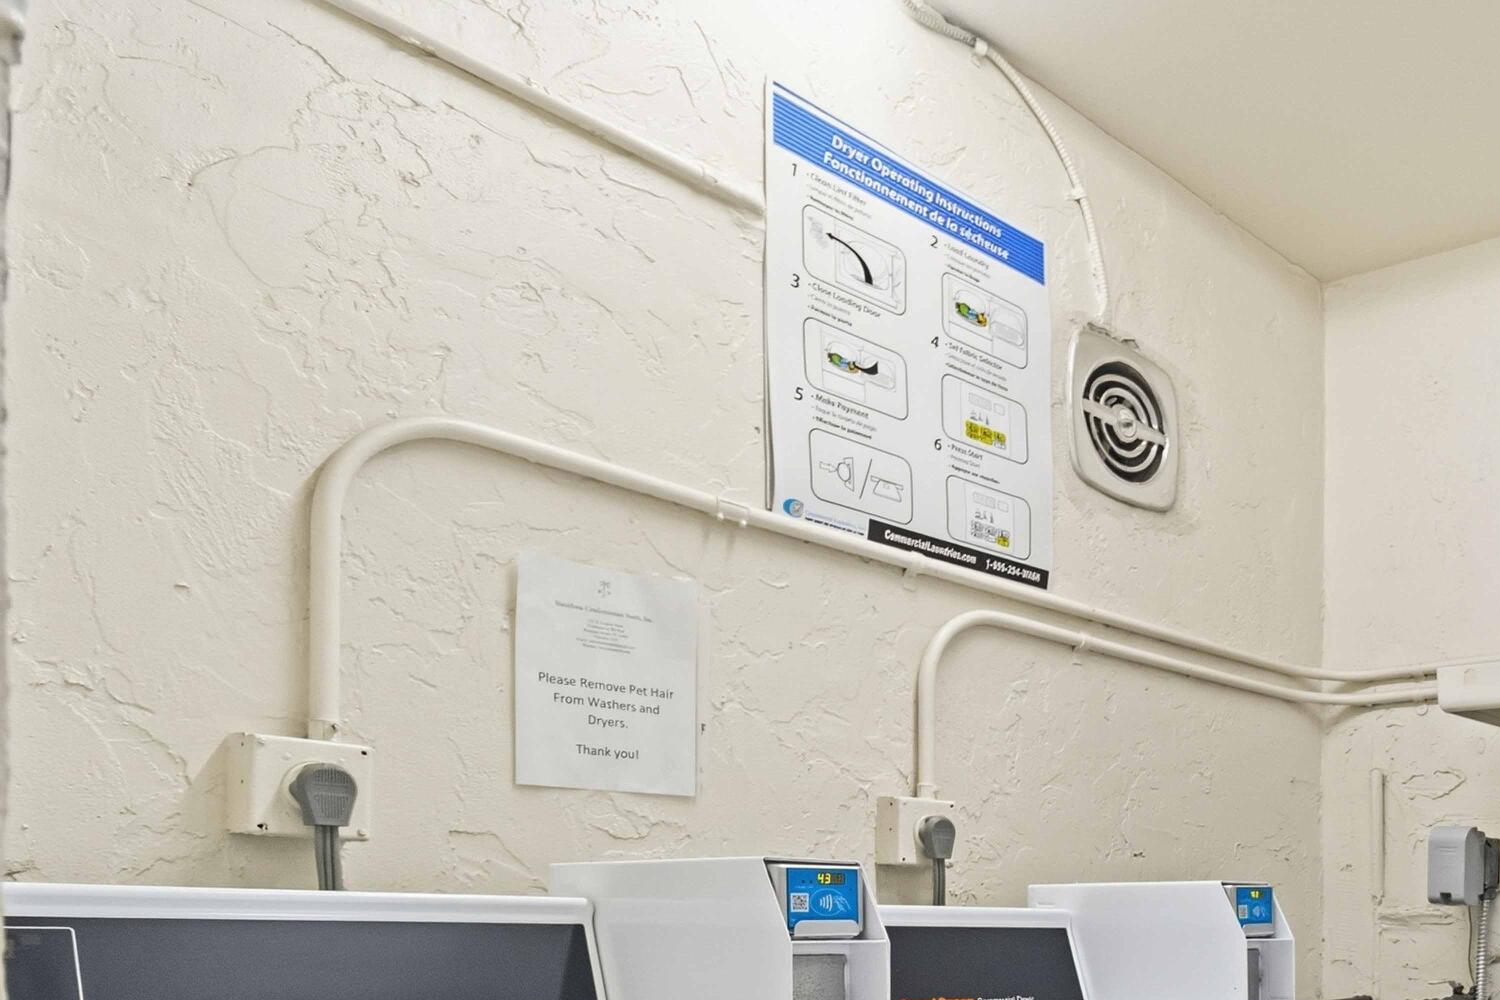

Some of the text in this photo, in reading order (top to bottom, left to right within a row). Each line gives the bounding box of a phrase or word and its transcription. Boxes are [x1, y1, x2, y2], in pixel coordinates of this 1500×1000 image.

[791, 163, 797, 176] 1
[823, 151, 929, 217] Fonctionnement
[929, 210, 945, 226] de
[946, 218, 959, 233] la
[831, 135, 869, 164] Dryer
[870, 153, 934, 203] Operating
[934, 193, 1002, 239] Instructions
[930, 235, 938, 249] 2
[790, 273, 800, 288] 3
[931, 336, 939, 348] 4
[794, 387, 804, 401] 5
[934, 438, 942, 451] 6
[538, 671, 674, 700] Please Remove Pet Hair
[553, 692, 661, 715] From Washers and
[588, 714, 629, 729] Dryers.
[576, 744, 640, 760] Thank you!
[817, 873, 831, 884] 43
